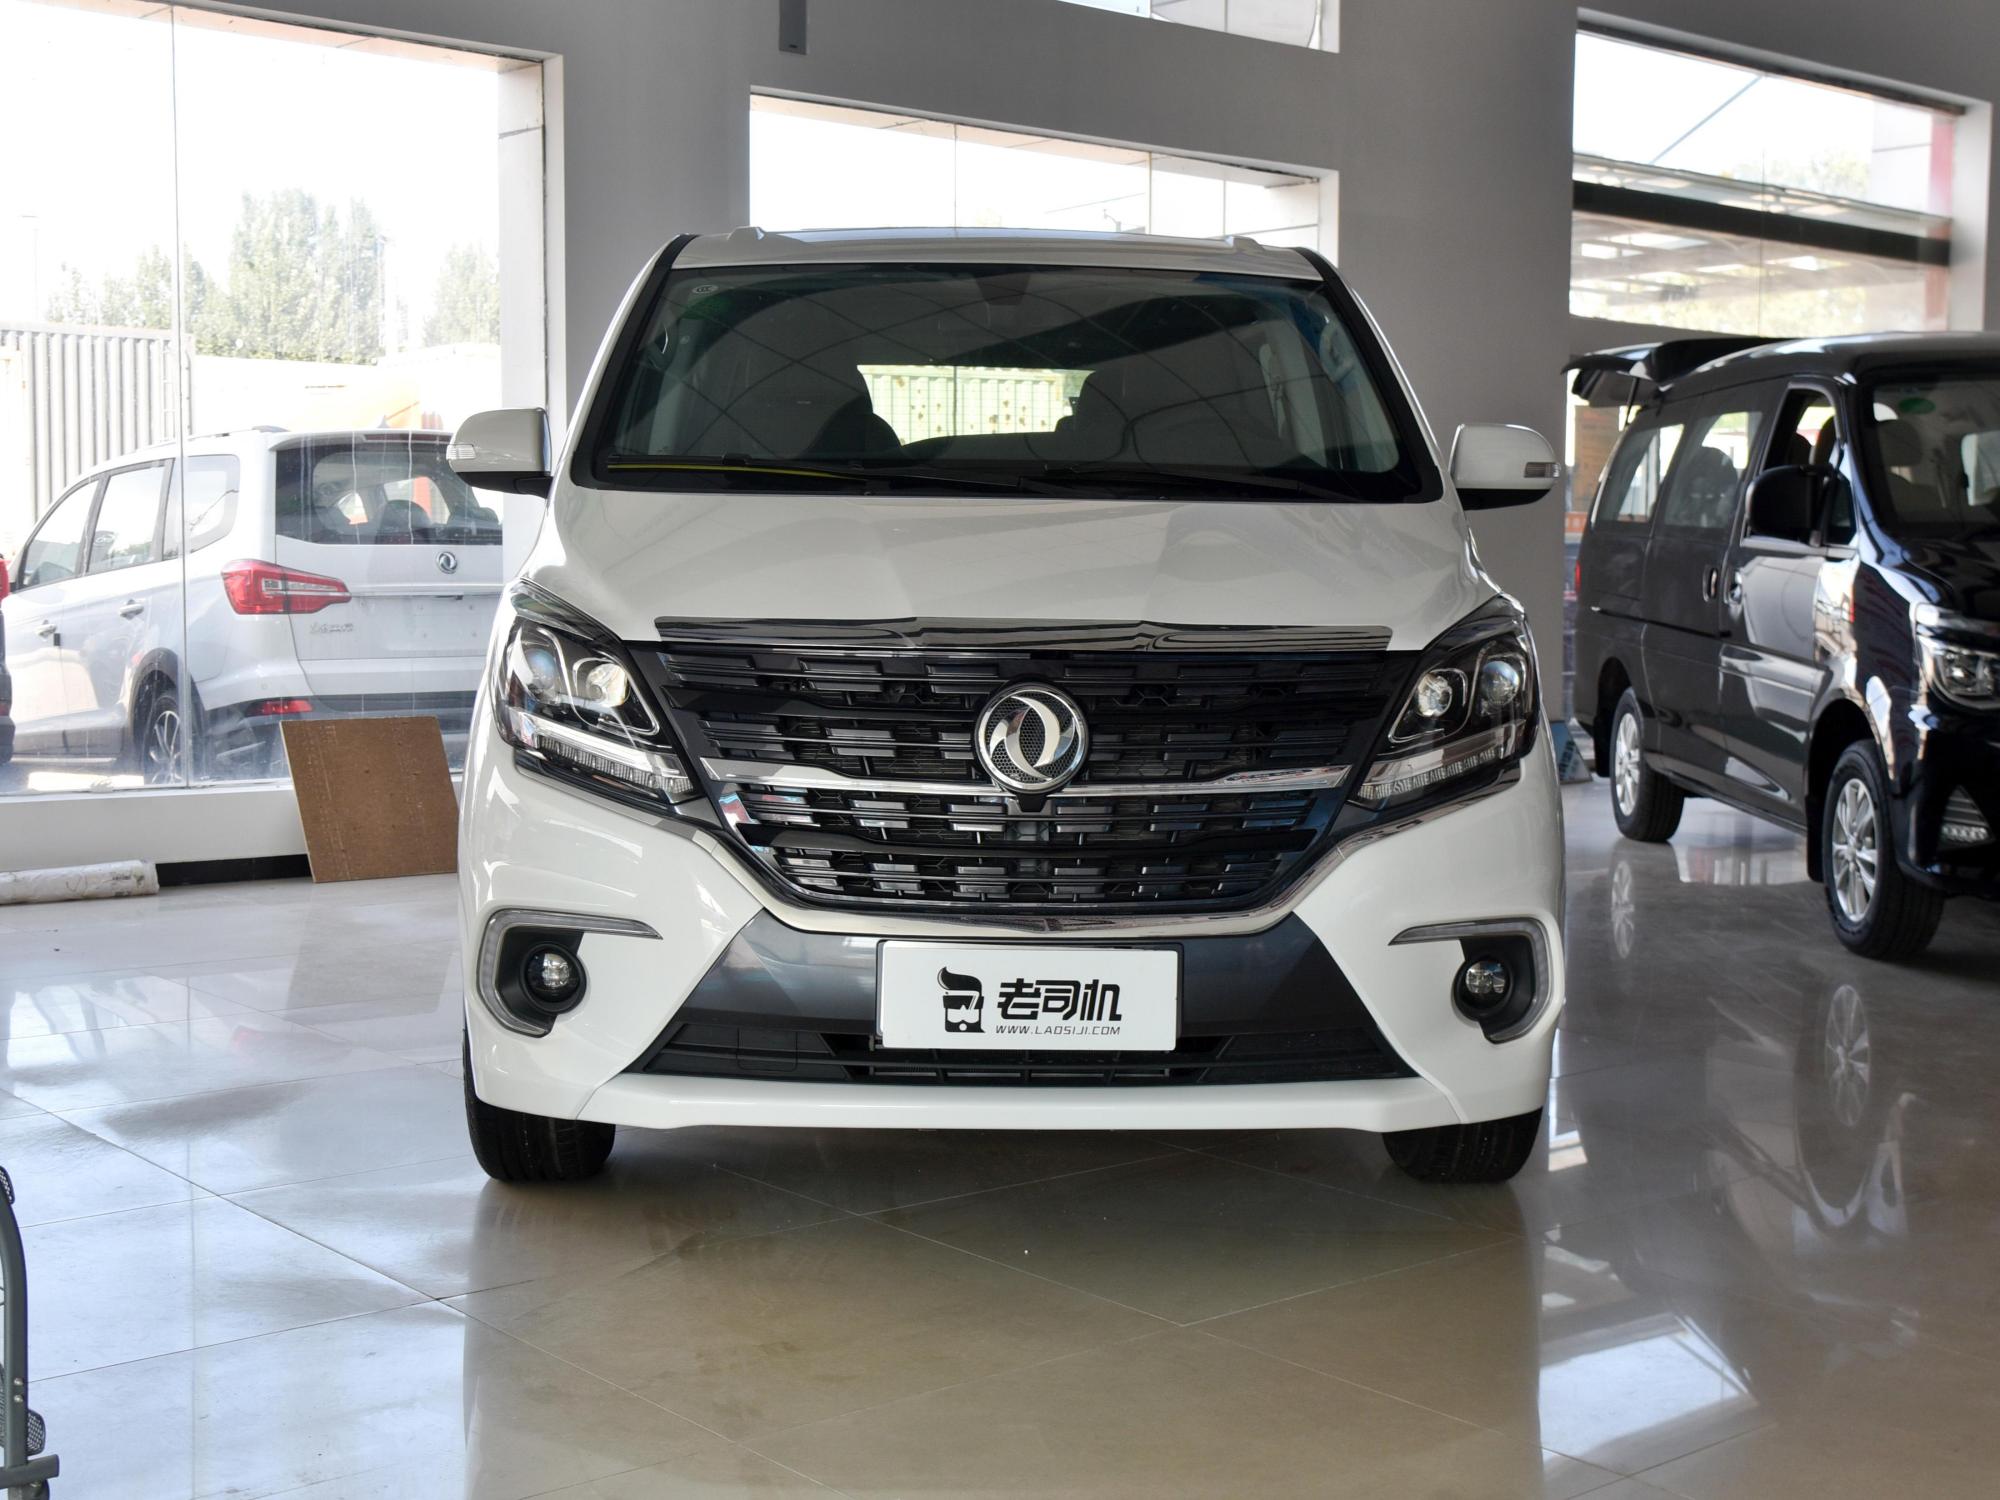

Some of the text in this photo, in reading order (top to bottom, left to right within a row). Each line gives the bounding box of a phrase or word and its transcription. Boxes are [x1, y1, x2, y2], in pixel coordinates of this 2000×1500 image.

[997, 978, 1122, 1021] 老司机
[995, 1025, 1121, 1035] WWW.LAOSIJI.COM
